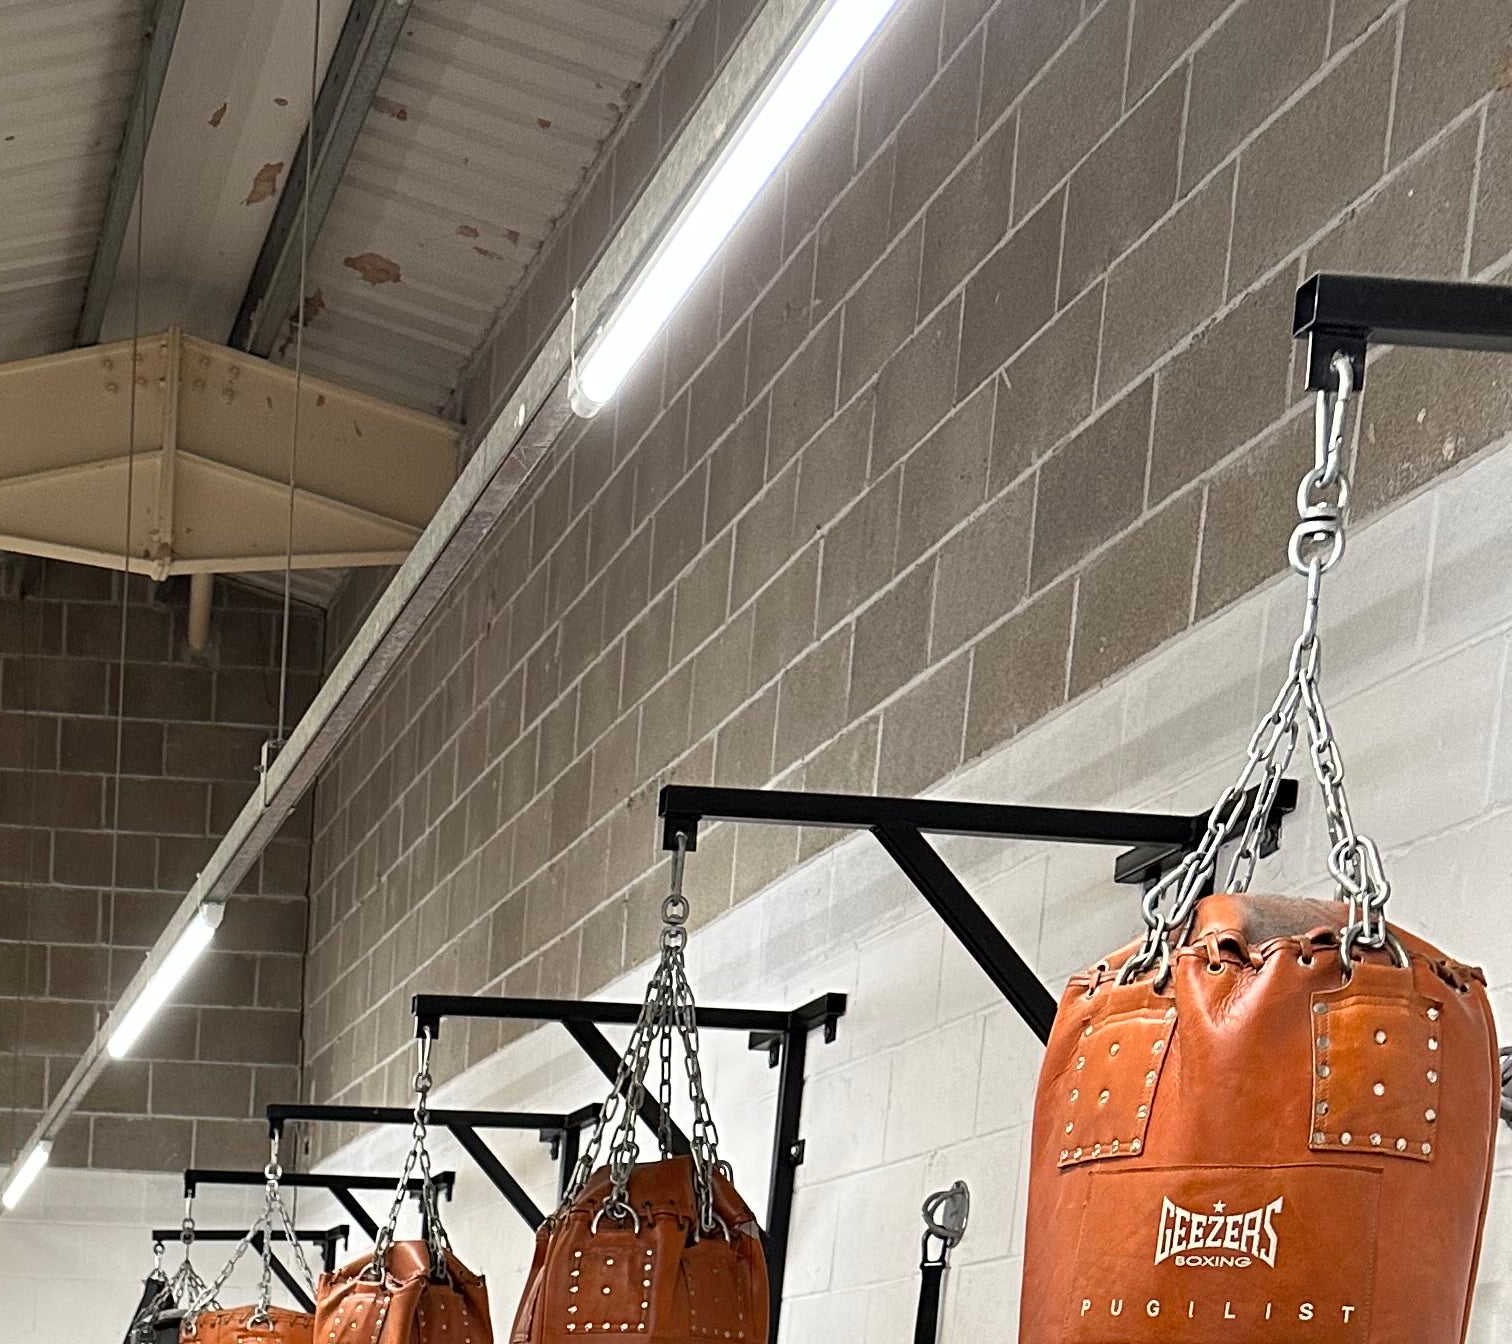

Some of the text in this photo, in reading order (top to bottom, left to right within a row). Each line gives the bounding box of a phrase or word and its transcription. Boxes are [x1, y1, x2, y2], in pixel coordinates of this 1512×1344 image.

[1154, 1195, 1284, 1269] GEEZERS
[1174, 1255, 1252, 1268] BOXING
[1080, 1299, 1355, 1323] PUGILIST
